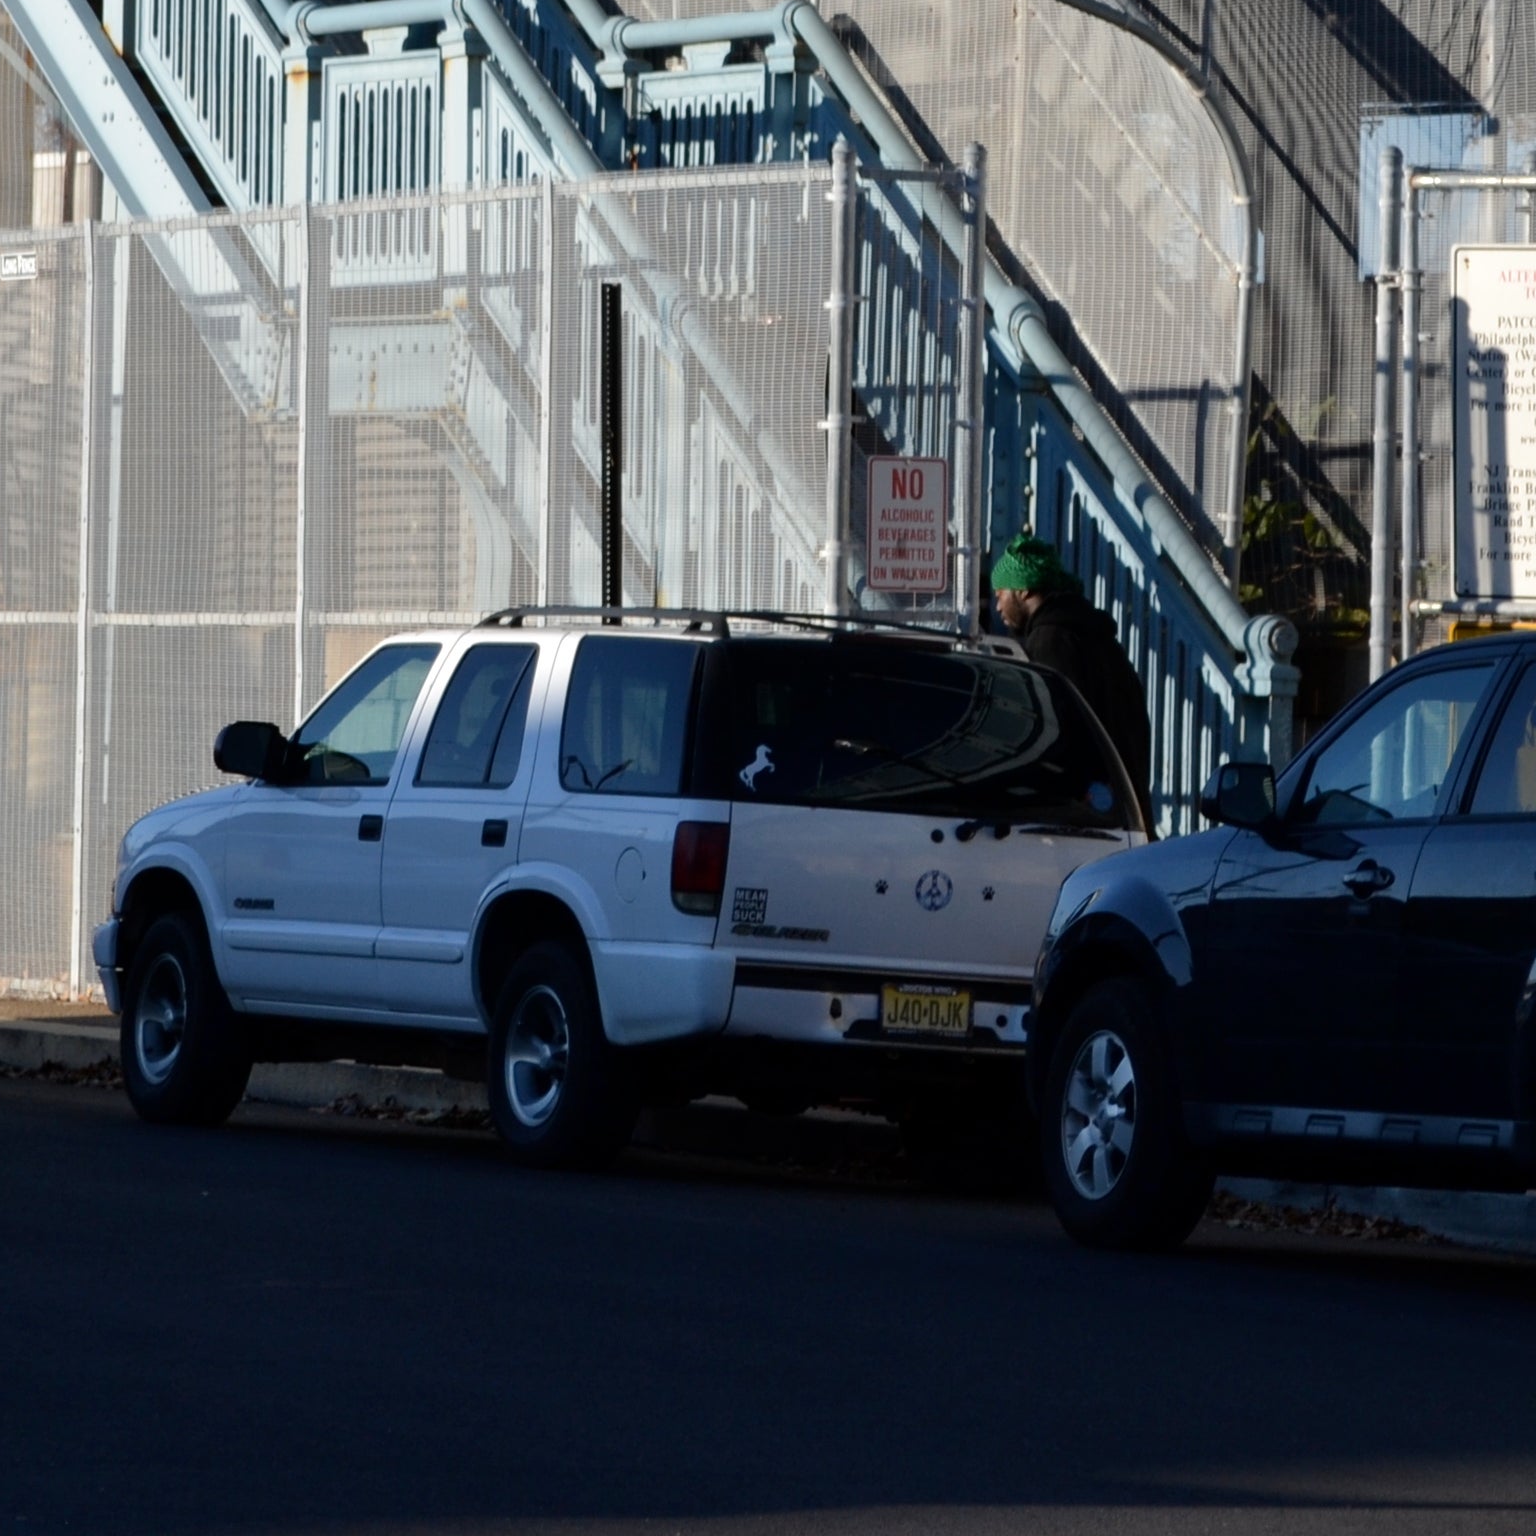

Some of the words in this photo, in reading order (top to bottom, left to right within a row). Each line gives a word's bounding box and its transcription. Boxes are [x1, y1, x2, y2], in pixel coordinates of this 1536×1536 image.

[1468, 349, 1510, 363] Station
[1466, 366, 1509, 381] Center)
[1514, 370, 1526, 380] or
[1470, 399, 1489, 412] For
[1494, 402, 1522, 412] more
[1484, 464, 1499, 478] NJ
[891, 467, 924, 501] NO
[1469, 481, 1520, 496] Franklin
[1484, 498, 1521, 513] Bridge
[880, 508, 935, 523] ALCOHOLIC
[1493, 515, 1523, 527] Rand
[878, 528, 936, 543] BEVERAGES
[879, 547, 935, 562] PERMITTED
[1479, 547, 1497, 560] For
[1504, 551, 1532, 561] more
[873, 566, 887, 580] ON
[891, 567, 940, 581] WALKWAY
[735, 889, 766, 901] MEAN
[734, 900, 764, 911] PEOPLE
[734, 910, 764, 921] SUCK
